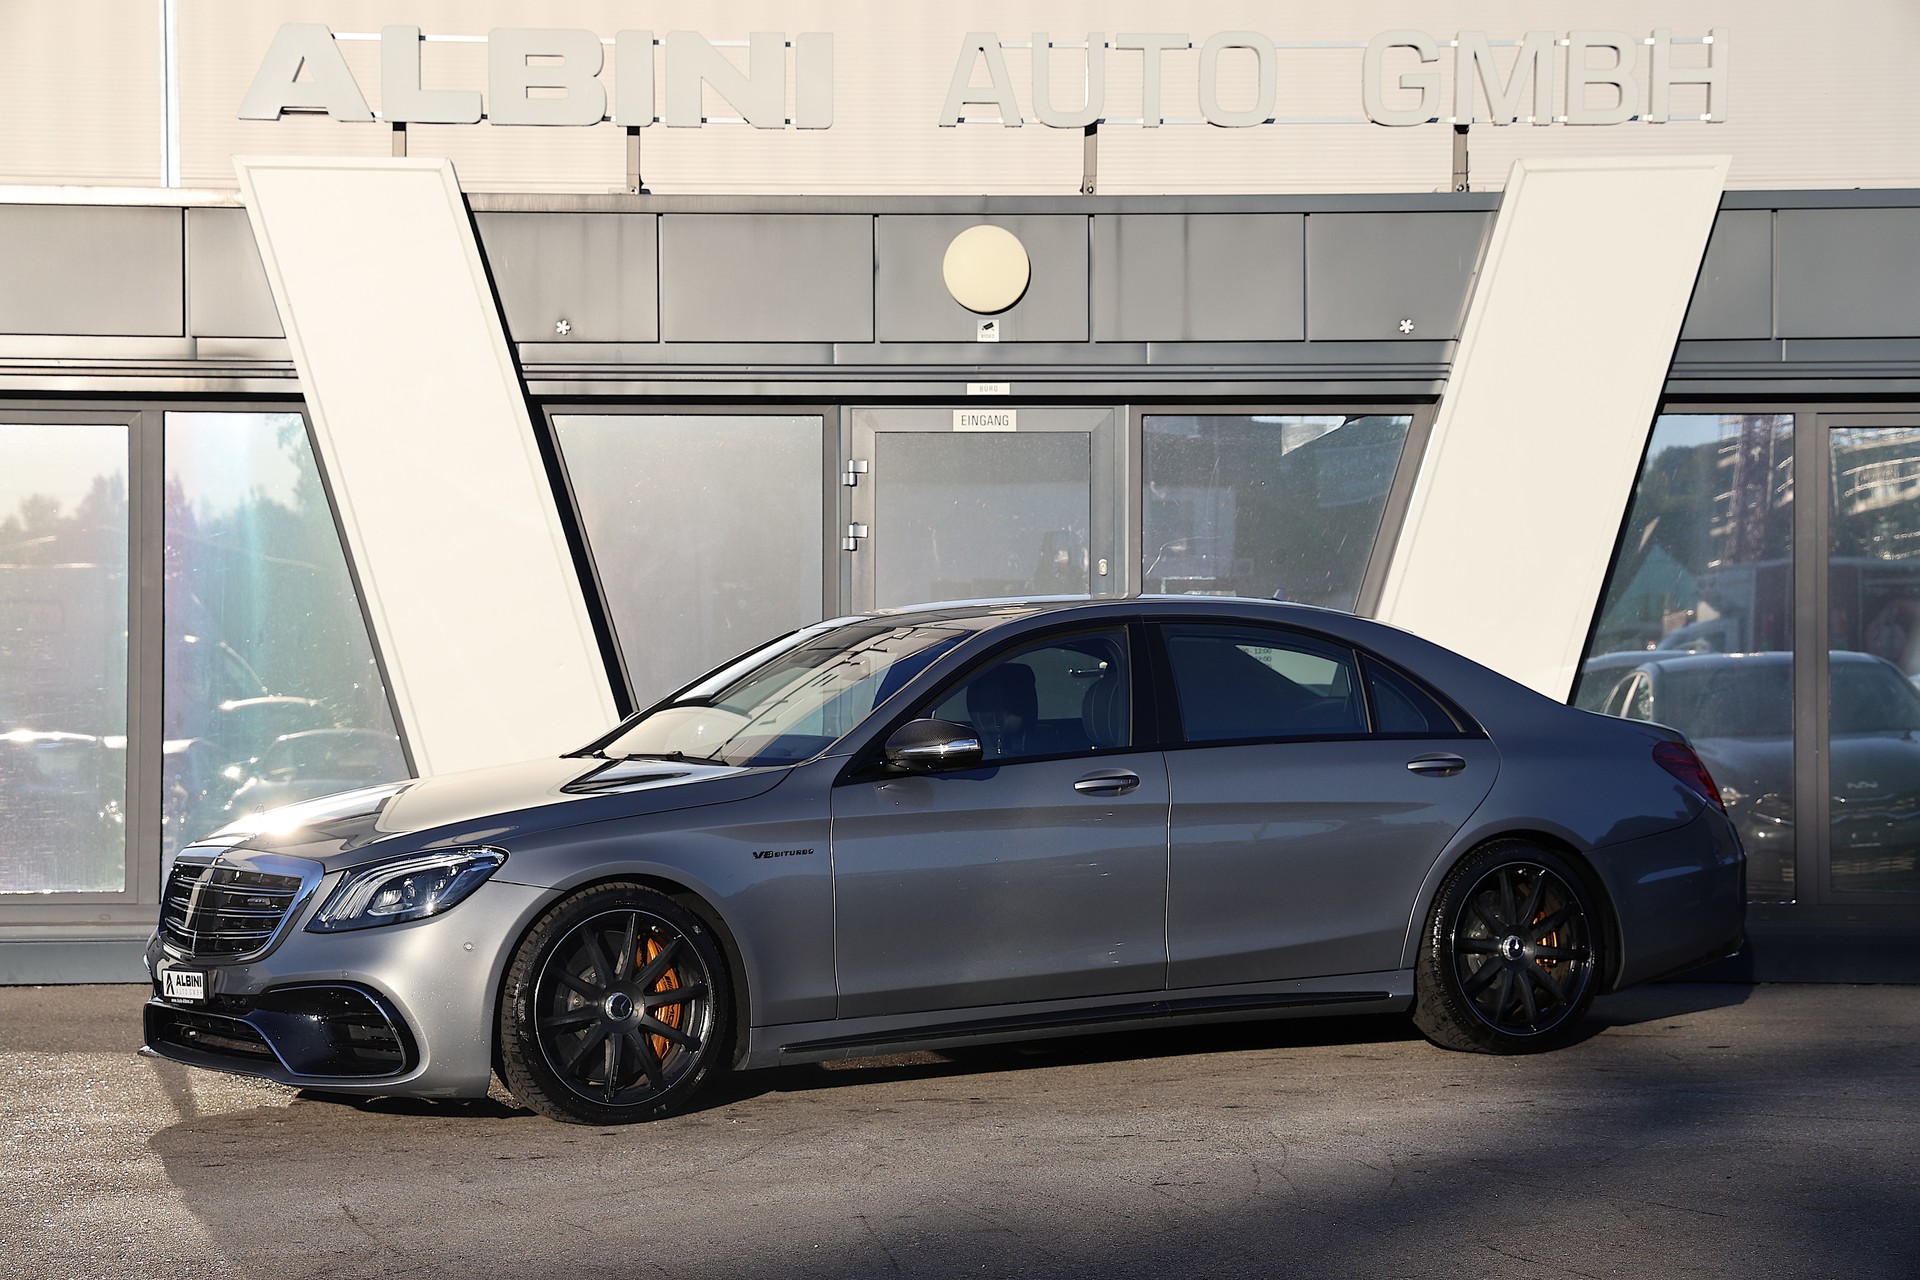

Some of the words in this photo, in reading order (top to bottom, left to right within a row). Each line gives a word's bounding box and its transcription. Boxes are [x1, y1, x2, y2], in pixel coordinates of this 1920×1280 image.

[238, 23, 834, 130] ALBINI
[939, 32, 1278, 129] AUTO
[1362, 27, 1730, 127] GMBH
[961, 414, 1009, 426] EINGANG
[176, 974, 202, 988] ALBINI
